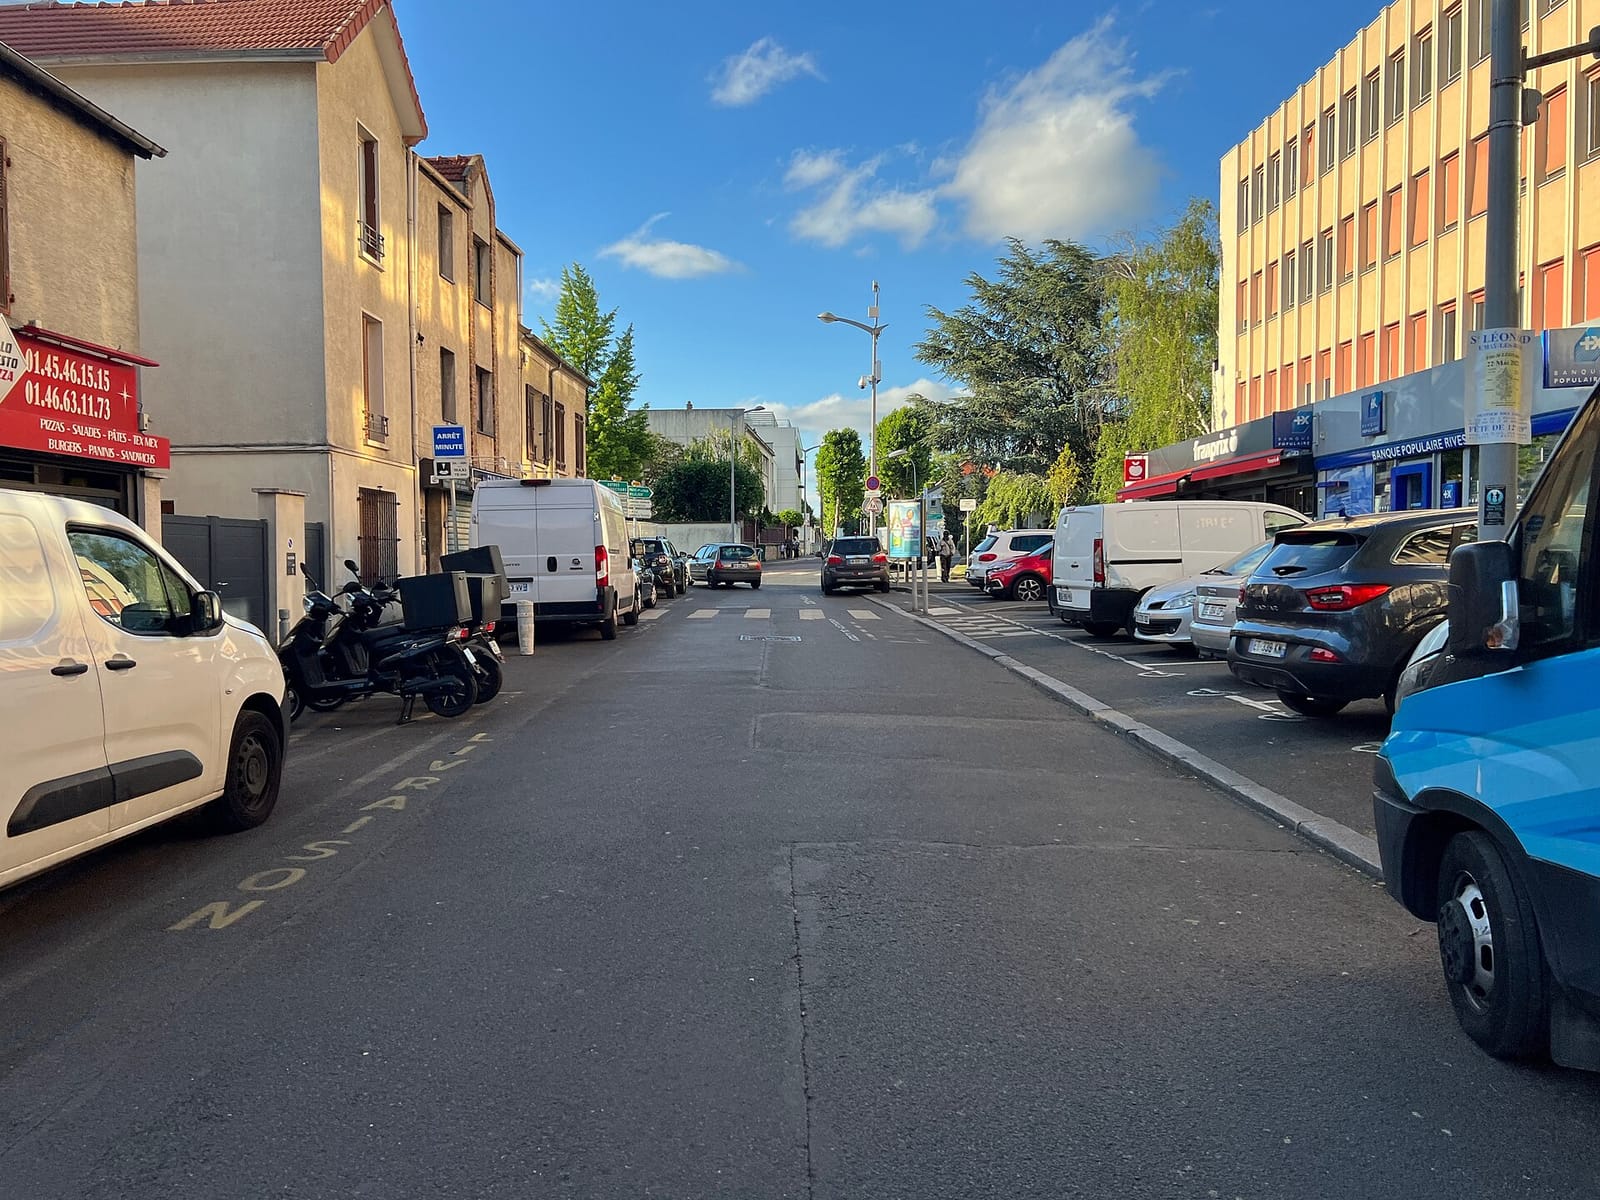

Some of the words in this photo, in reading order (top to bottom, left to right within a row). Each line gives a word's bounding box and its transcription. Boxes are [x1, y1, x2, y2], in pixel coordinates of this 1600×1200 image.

[1483, 331, 1531, 345] LÉOND
[25, 348, 110, 392] 01.45.46.15.15
[25, 380, 111, 421] 01.46.63.11.73
[40, 418, 65, 433] PIZZAS
[72, 424, 101, 439] SALADES
[108, 428, 127, 443] PÂTES
[133, 434, 144, 446] TEX
[145, 437, 158, 449] MEX
[437, 432, 460, 440] ARRÊT
[48, 438, 82, 454] BURGERS
[88, 444, 115, 458] PANINIS
[1371, 446, 1401, 461] BANQUE
[1401, 438, 1443, 455] POPULAIRE
[1444, 434, 1466, 449] RIVES
